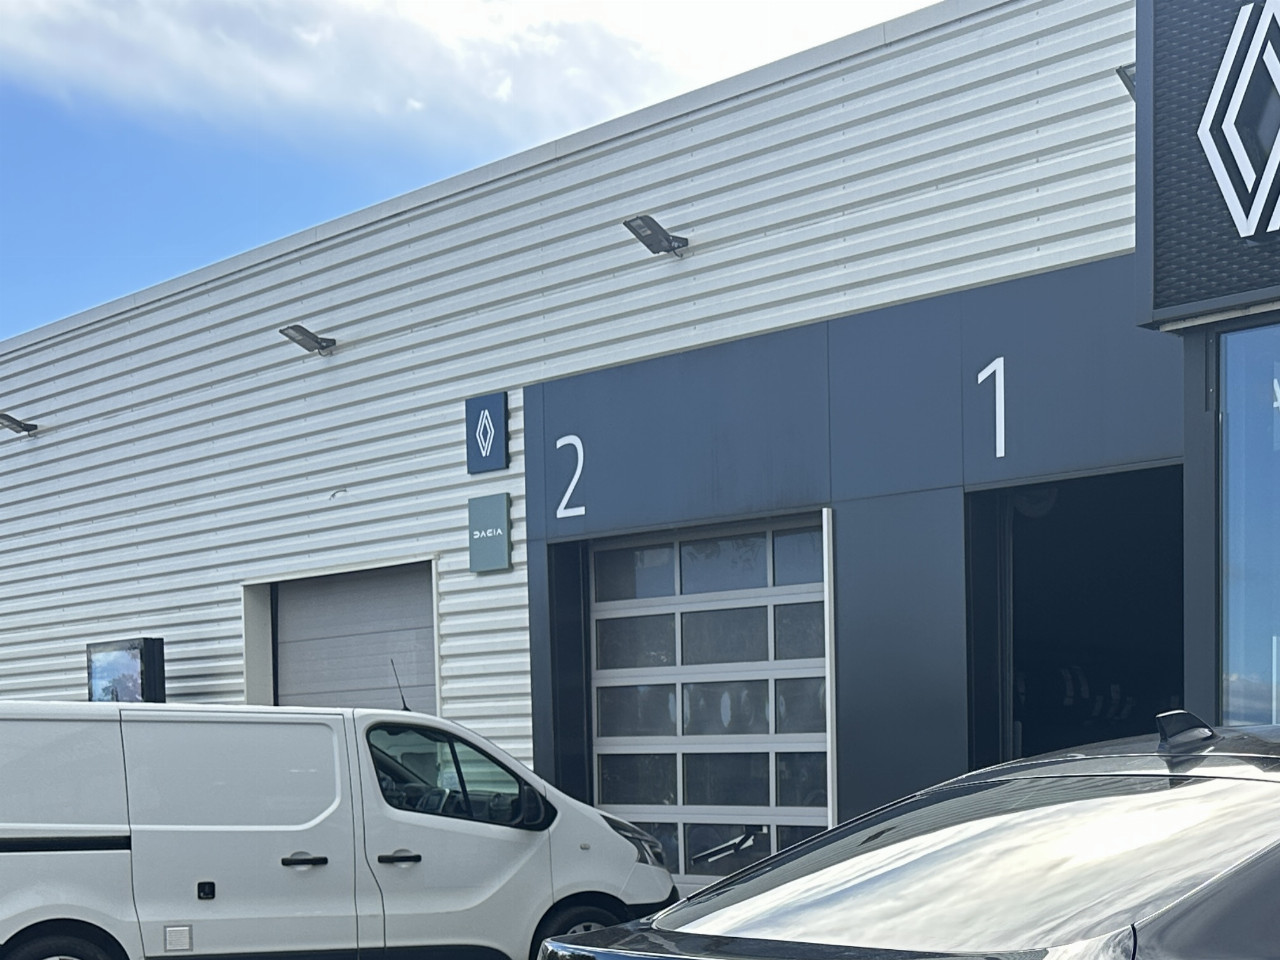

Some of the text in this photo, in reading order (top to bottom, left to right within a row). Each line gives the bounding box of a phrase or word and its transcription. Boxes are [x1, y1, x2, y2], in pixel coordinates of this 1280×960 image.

[977, 356, 1005, 458] 1
[556, 434, 586, 518] 2
[473, 528, 503, 539] DACIA
